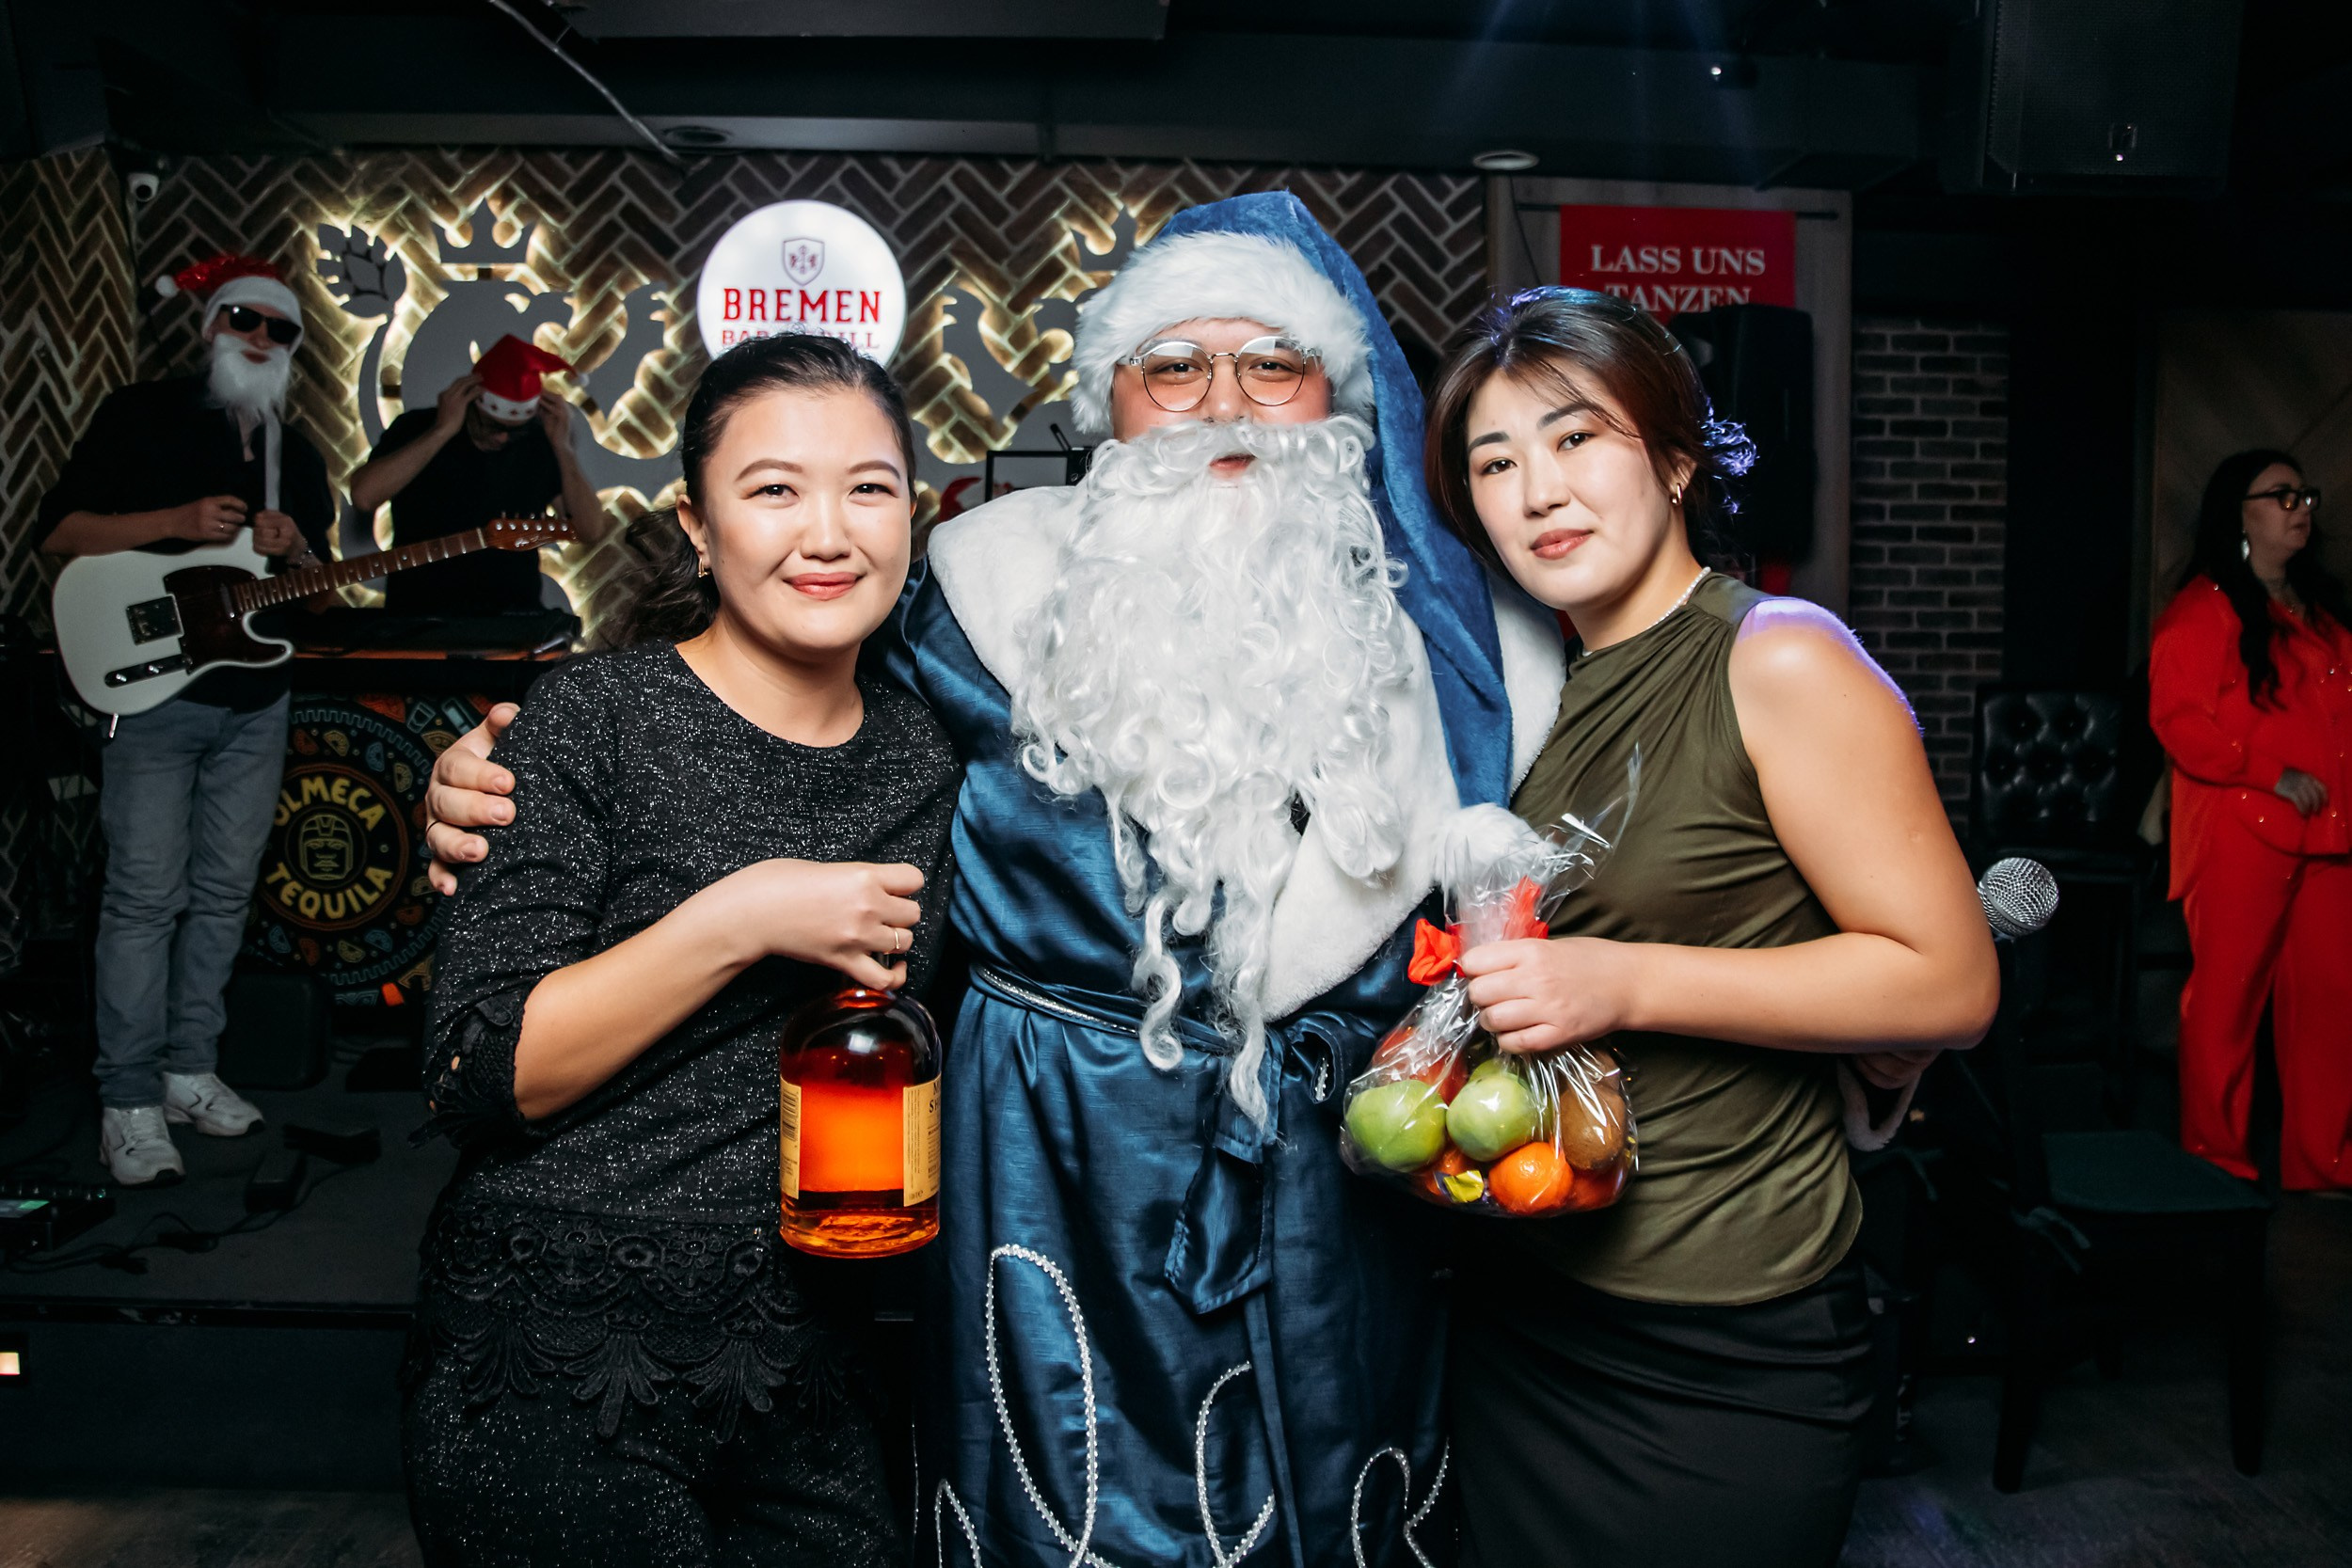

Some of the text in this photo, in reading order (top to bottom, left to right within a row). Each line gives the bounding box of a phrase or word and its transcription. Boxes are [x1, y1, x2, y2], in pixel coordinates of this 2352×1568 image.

[1591, 245, 1766, 276] LASS UNS
[723, 288, 881, 324] BREMEN
[1605, 284, 1751, 313] TANZEN
[265, 862, 393, 920] TEQUILA
